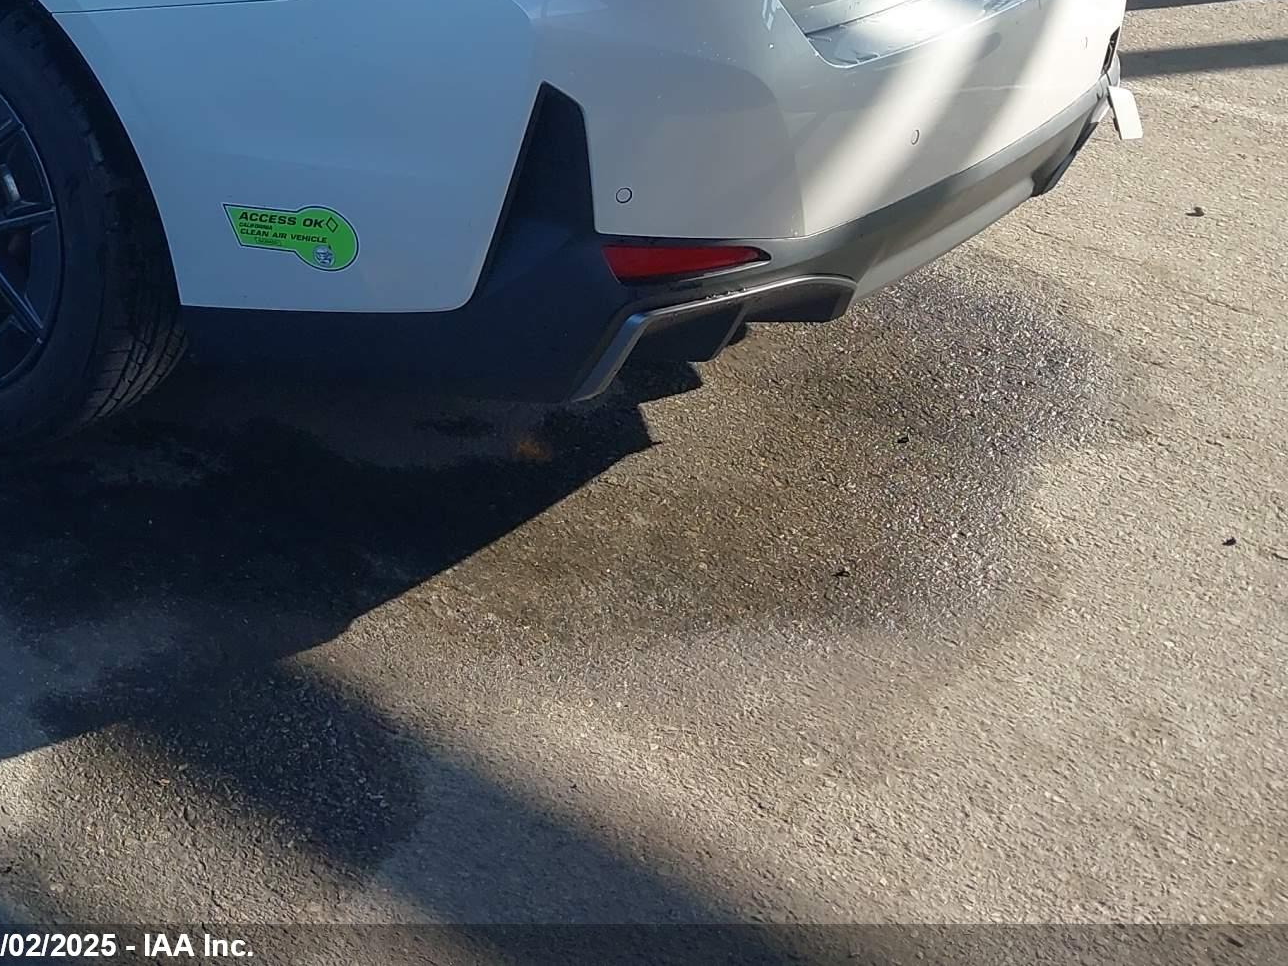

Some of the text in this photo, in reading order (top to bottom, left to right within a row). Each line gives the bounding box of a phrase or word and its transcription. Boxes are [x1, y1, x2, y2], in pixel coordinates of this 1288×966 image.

[238, 211, 325, 229] ACCESS OK
[240, 228, 270, 237] CLEAN
[272, 232, 288, 240] AIR
[290, 234, 328, 244] VEHICLE
